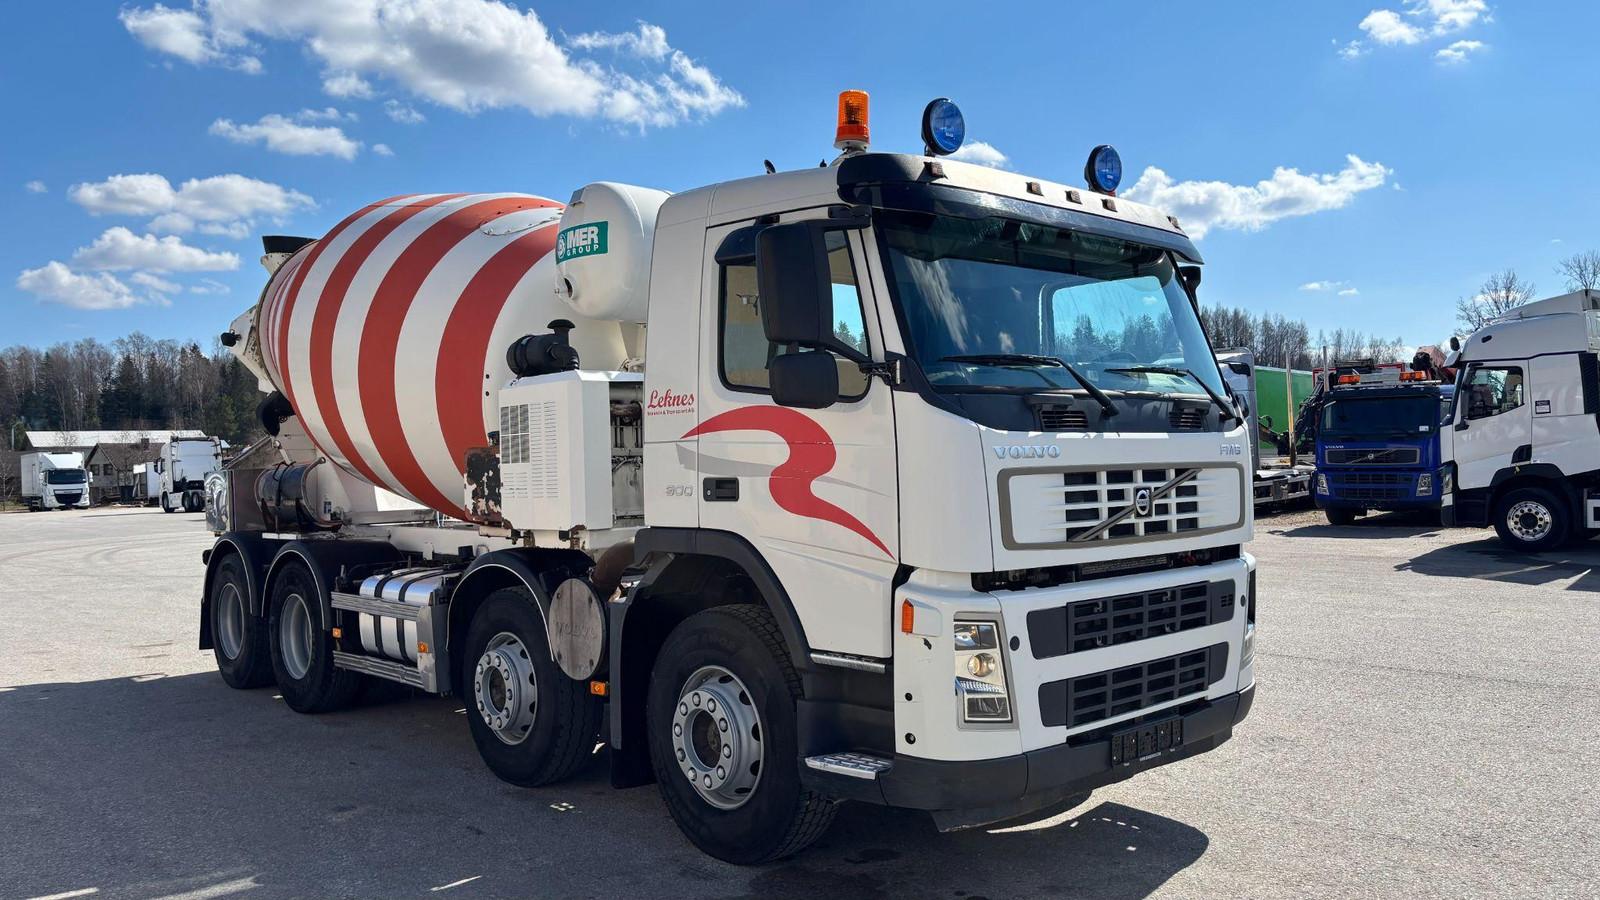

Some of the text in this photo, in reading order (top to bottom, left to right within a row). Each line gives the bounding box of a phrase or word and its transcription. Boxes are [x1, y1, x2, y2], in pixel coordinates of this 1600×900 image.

[567, 226, 599, 249] IMER
[566, 244, 599, 256] GROUP
[647, 388, 695, 409] Leknes
[992, 445, 1061, 459] VOLVO
